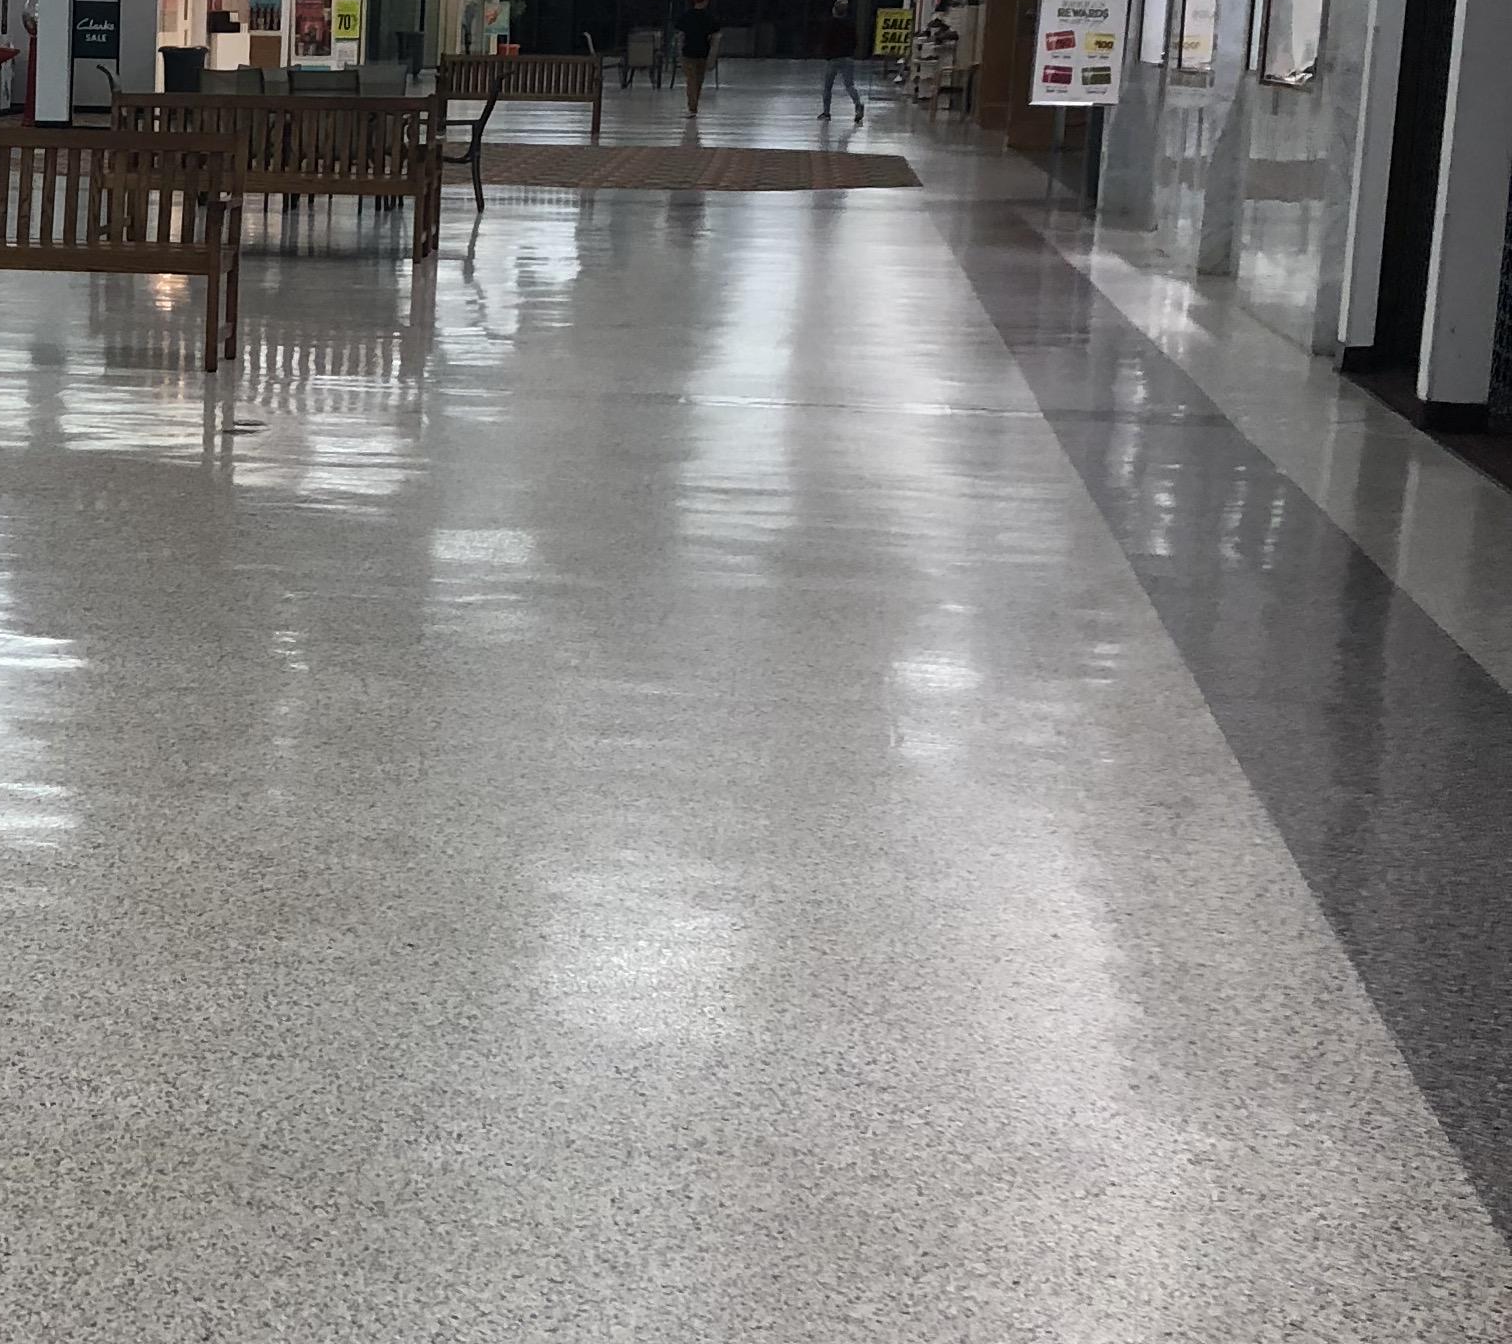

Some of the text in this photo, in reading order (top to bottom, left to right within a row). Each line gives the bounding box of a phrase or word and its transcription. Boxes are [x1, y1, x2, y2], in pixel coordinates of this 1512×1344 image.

[77, 17, 115, 31] Clarks
[882, 18, 912, 30] SALE
[85, 33, 107, 42] SALE
